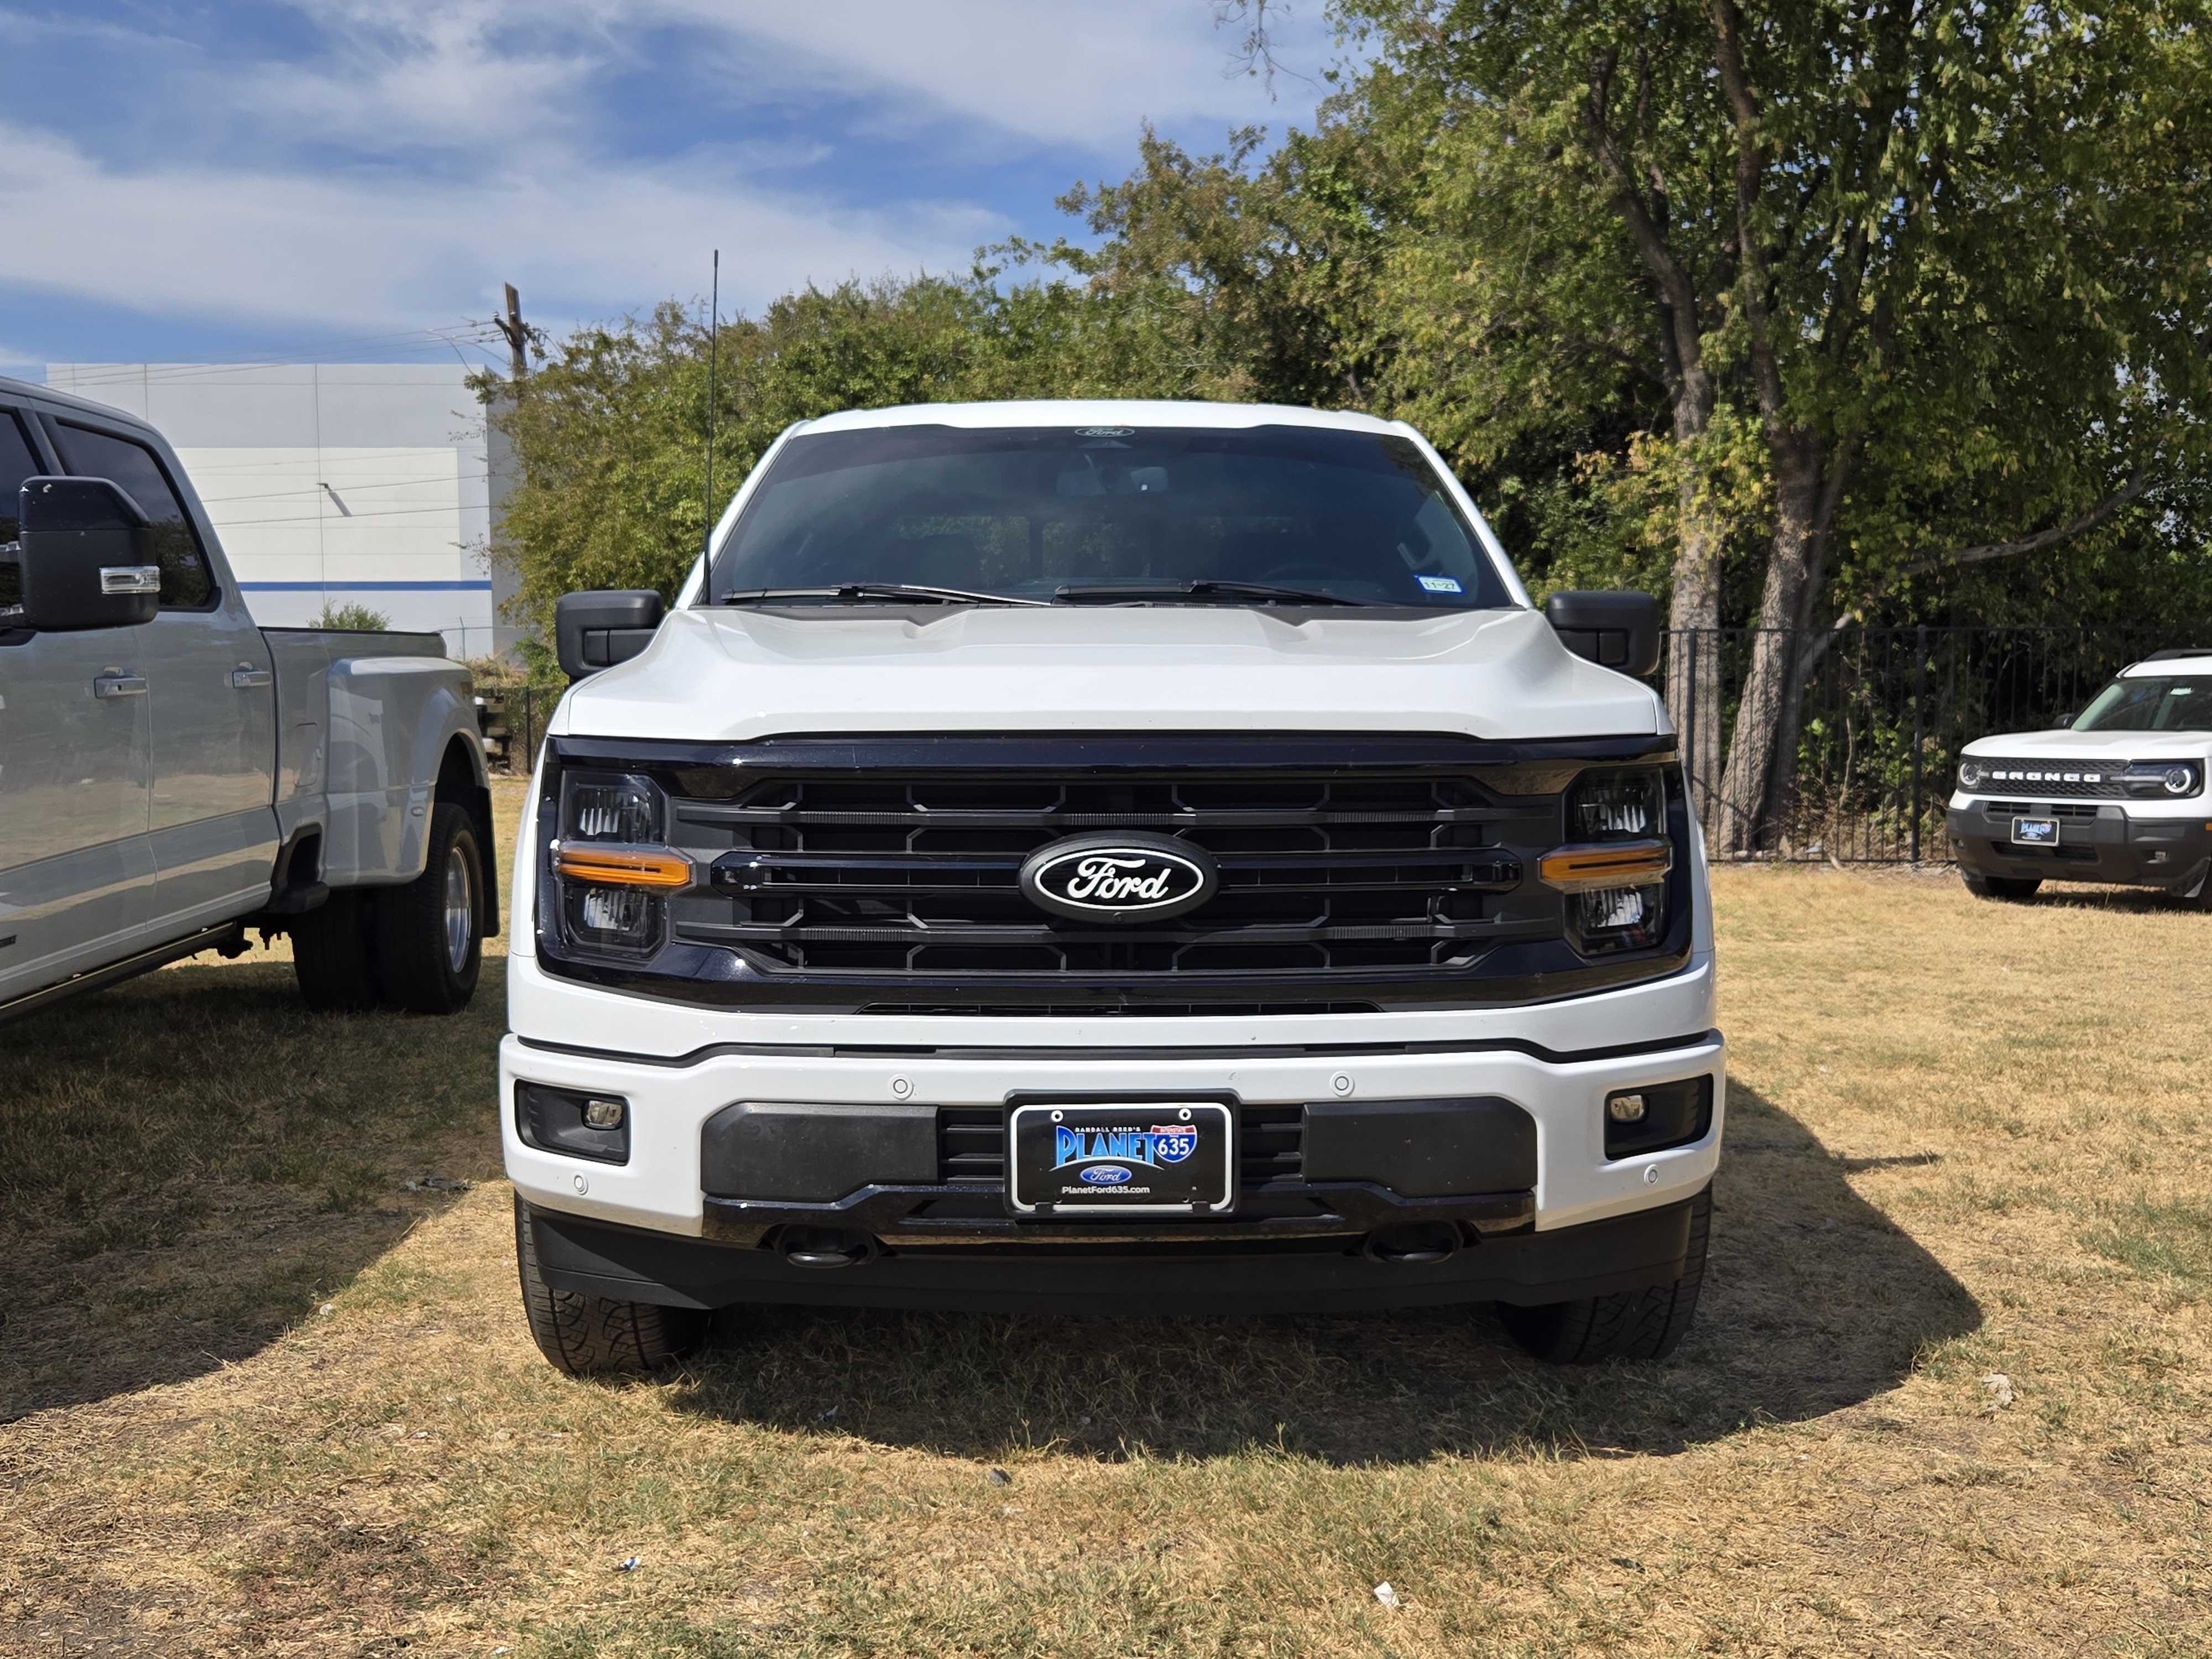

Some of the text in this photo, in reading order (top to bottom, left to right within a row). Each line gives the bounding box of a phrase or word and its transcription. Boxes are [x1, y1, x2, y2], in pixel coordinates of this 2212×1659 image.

[1992, 771, 2101, 782] BRONCO
[1067, 857, 1171, 899] Ford
[1056, 1125, 1157, 1166] PLANET
[1158, 1138, 1190, 1156] 635
[1090, 1167, 1121, 1181] Ford
[1061, 1185, 1150, 1194] PlanetFord635.com
